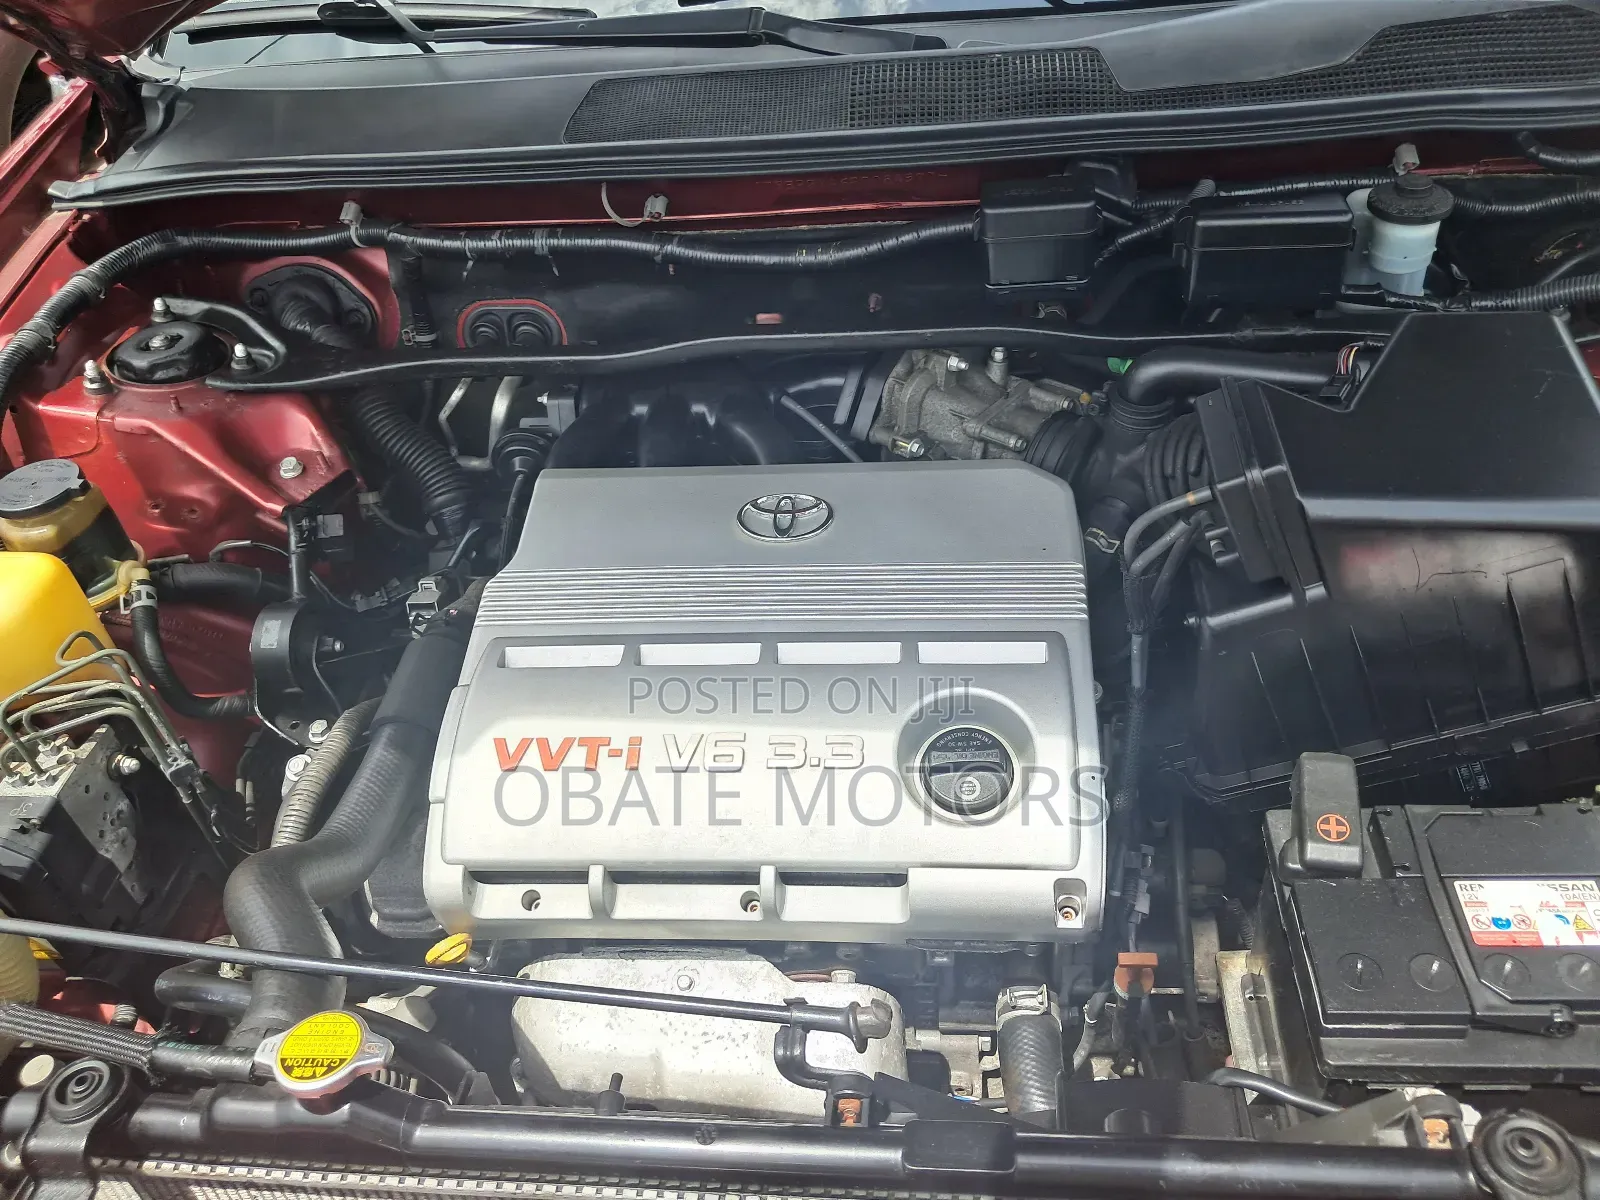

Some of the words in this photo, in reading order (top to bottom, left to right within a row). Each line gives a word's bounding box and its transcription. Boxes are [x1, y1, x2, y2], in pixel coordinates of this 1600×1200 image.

[493, 736, 642, 772] VVT-i
[662, 732, 746, 773] V6
[766, 734, 865, 770] 3.3
[285, 1058, 340, 1067] CAUTION
